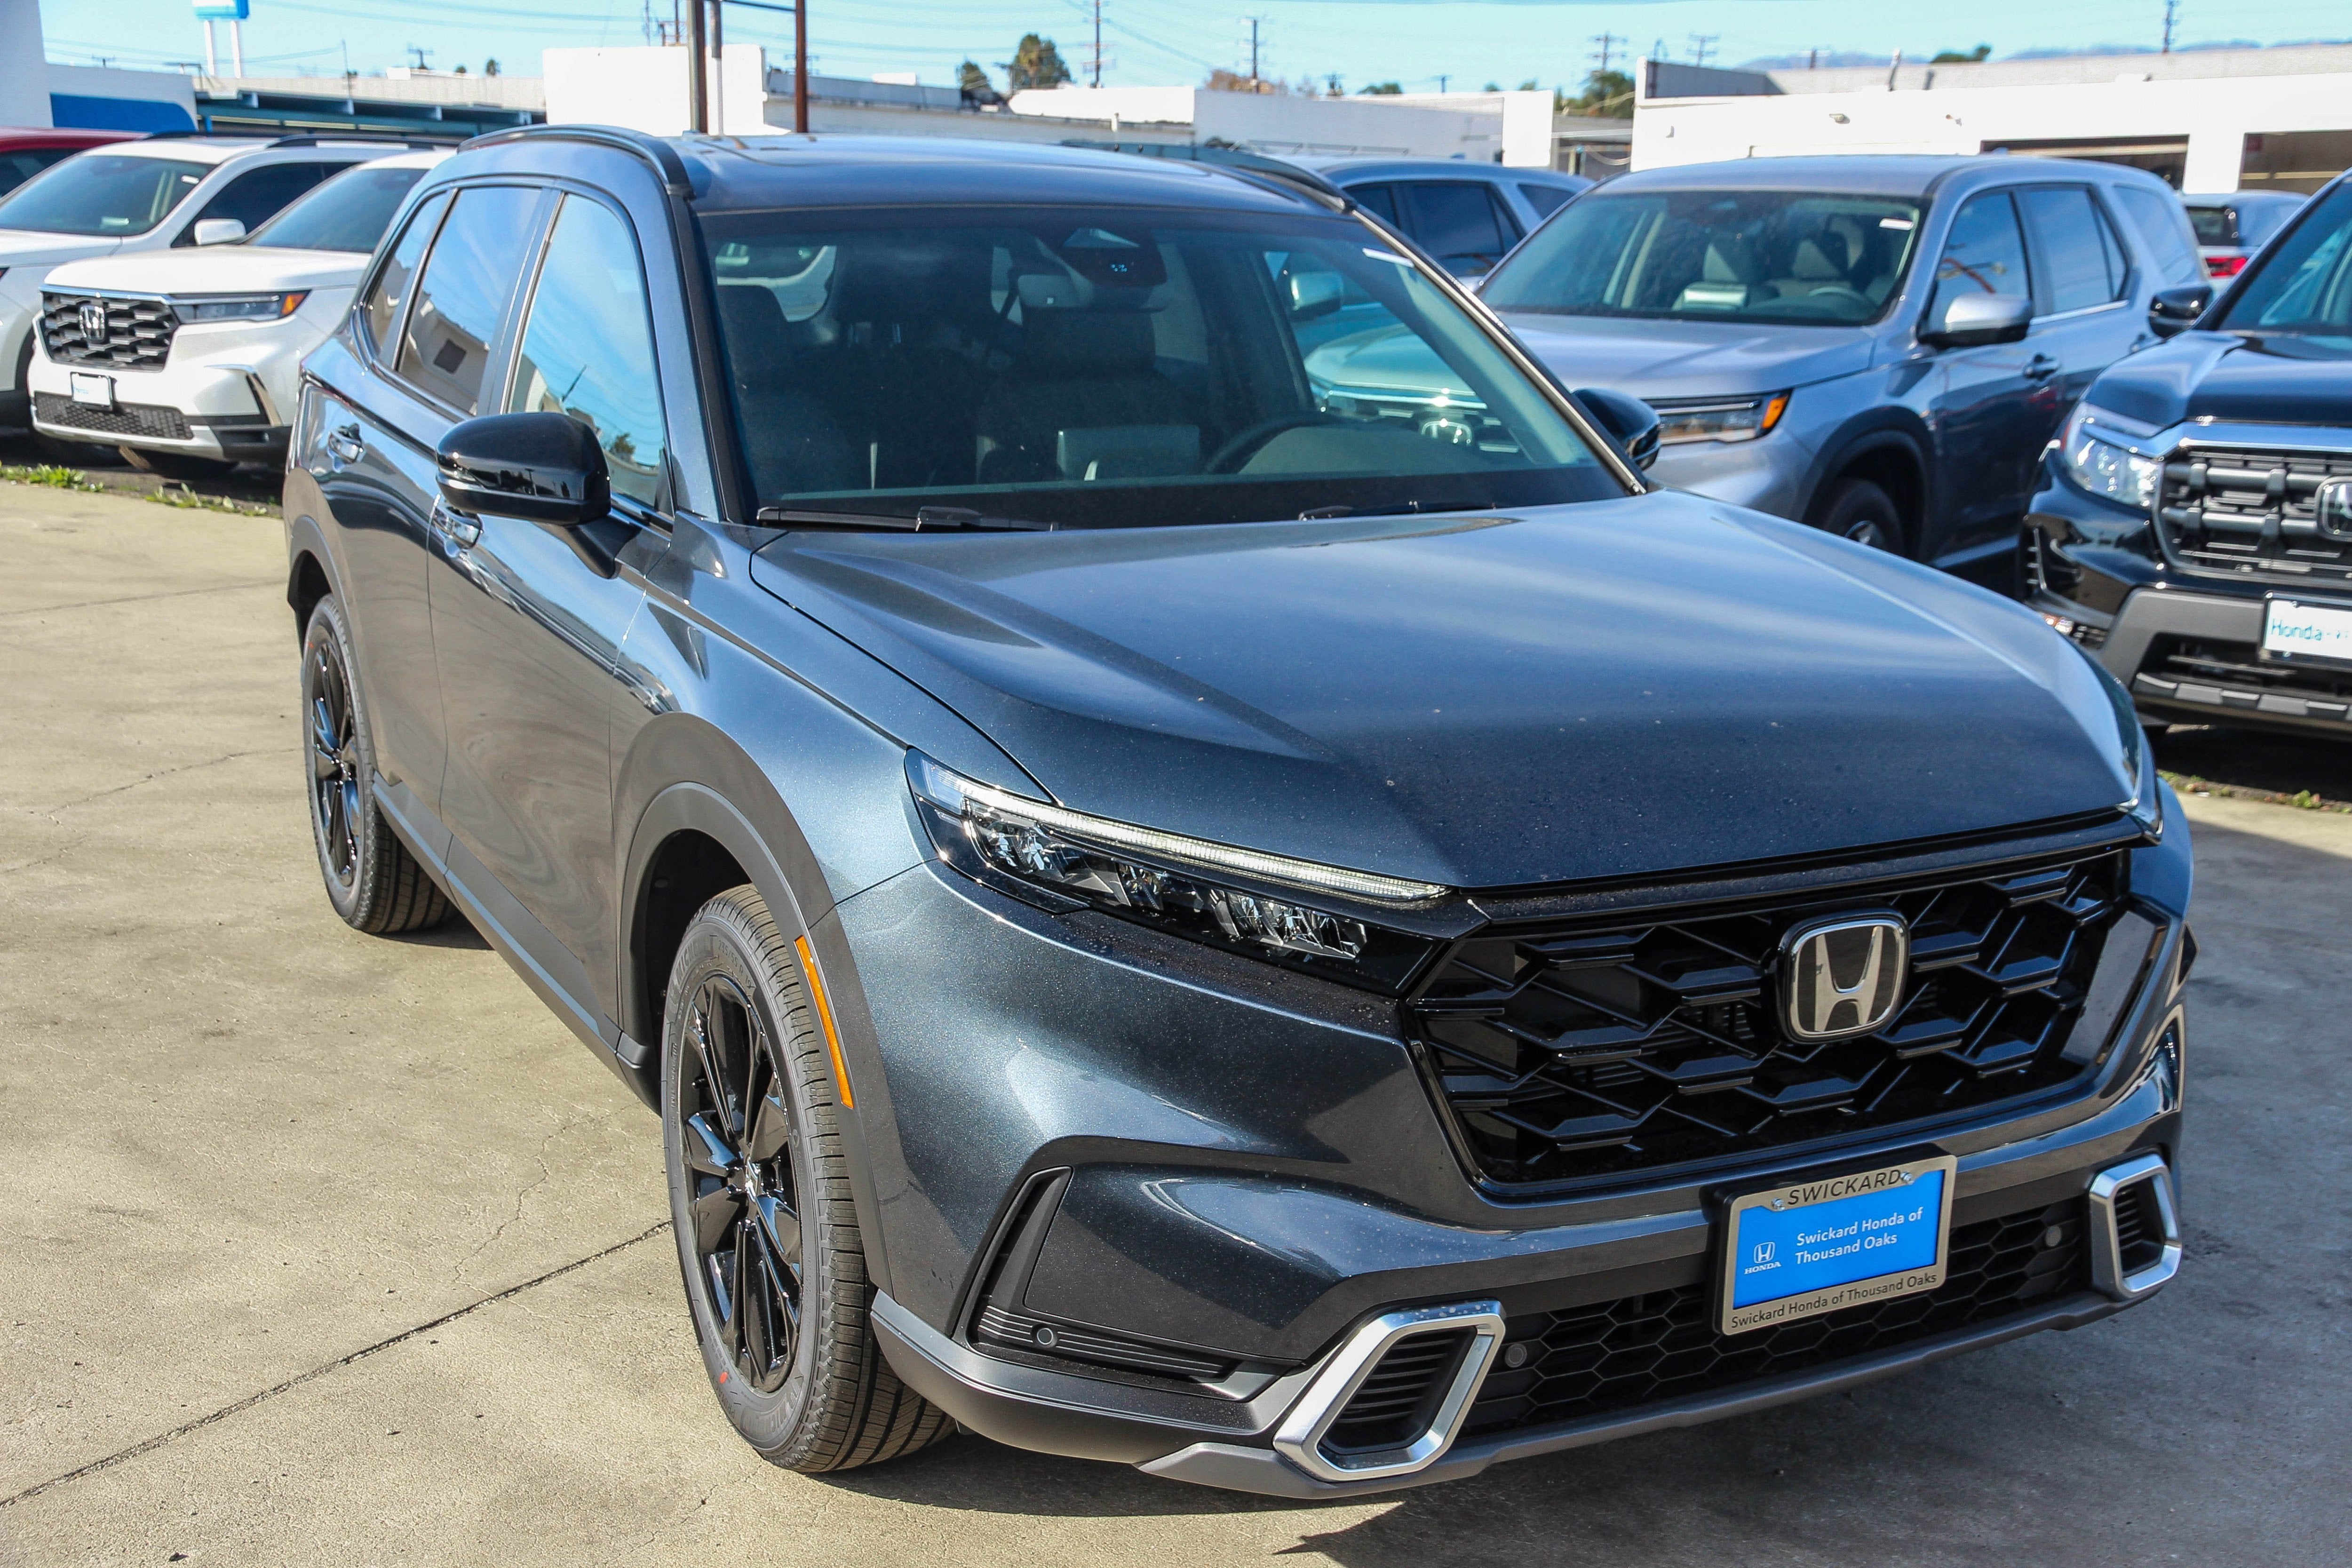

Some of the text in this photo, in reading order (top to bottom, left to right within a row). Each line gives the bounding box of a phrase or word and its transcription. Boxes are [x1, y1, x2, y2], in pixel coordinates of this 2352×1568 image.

[1788, 1170, 1900, 1205] SWICKARD
[1797, 1208, 1923, 1246] Swickard Honda of
[1795, 1234, 1897, 1264] Thousand Oaks
[1744, 1262, 1781, 1274] HONDA
[1732, 1274, 1937, 1328] Swickard Honda of Thousand Oaks
